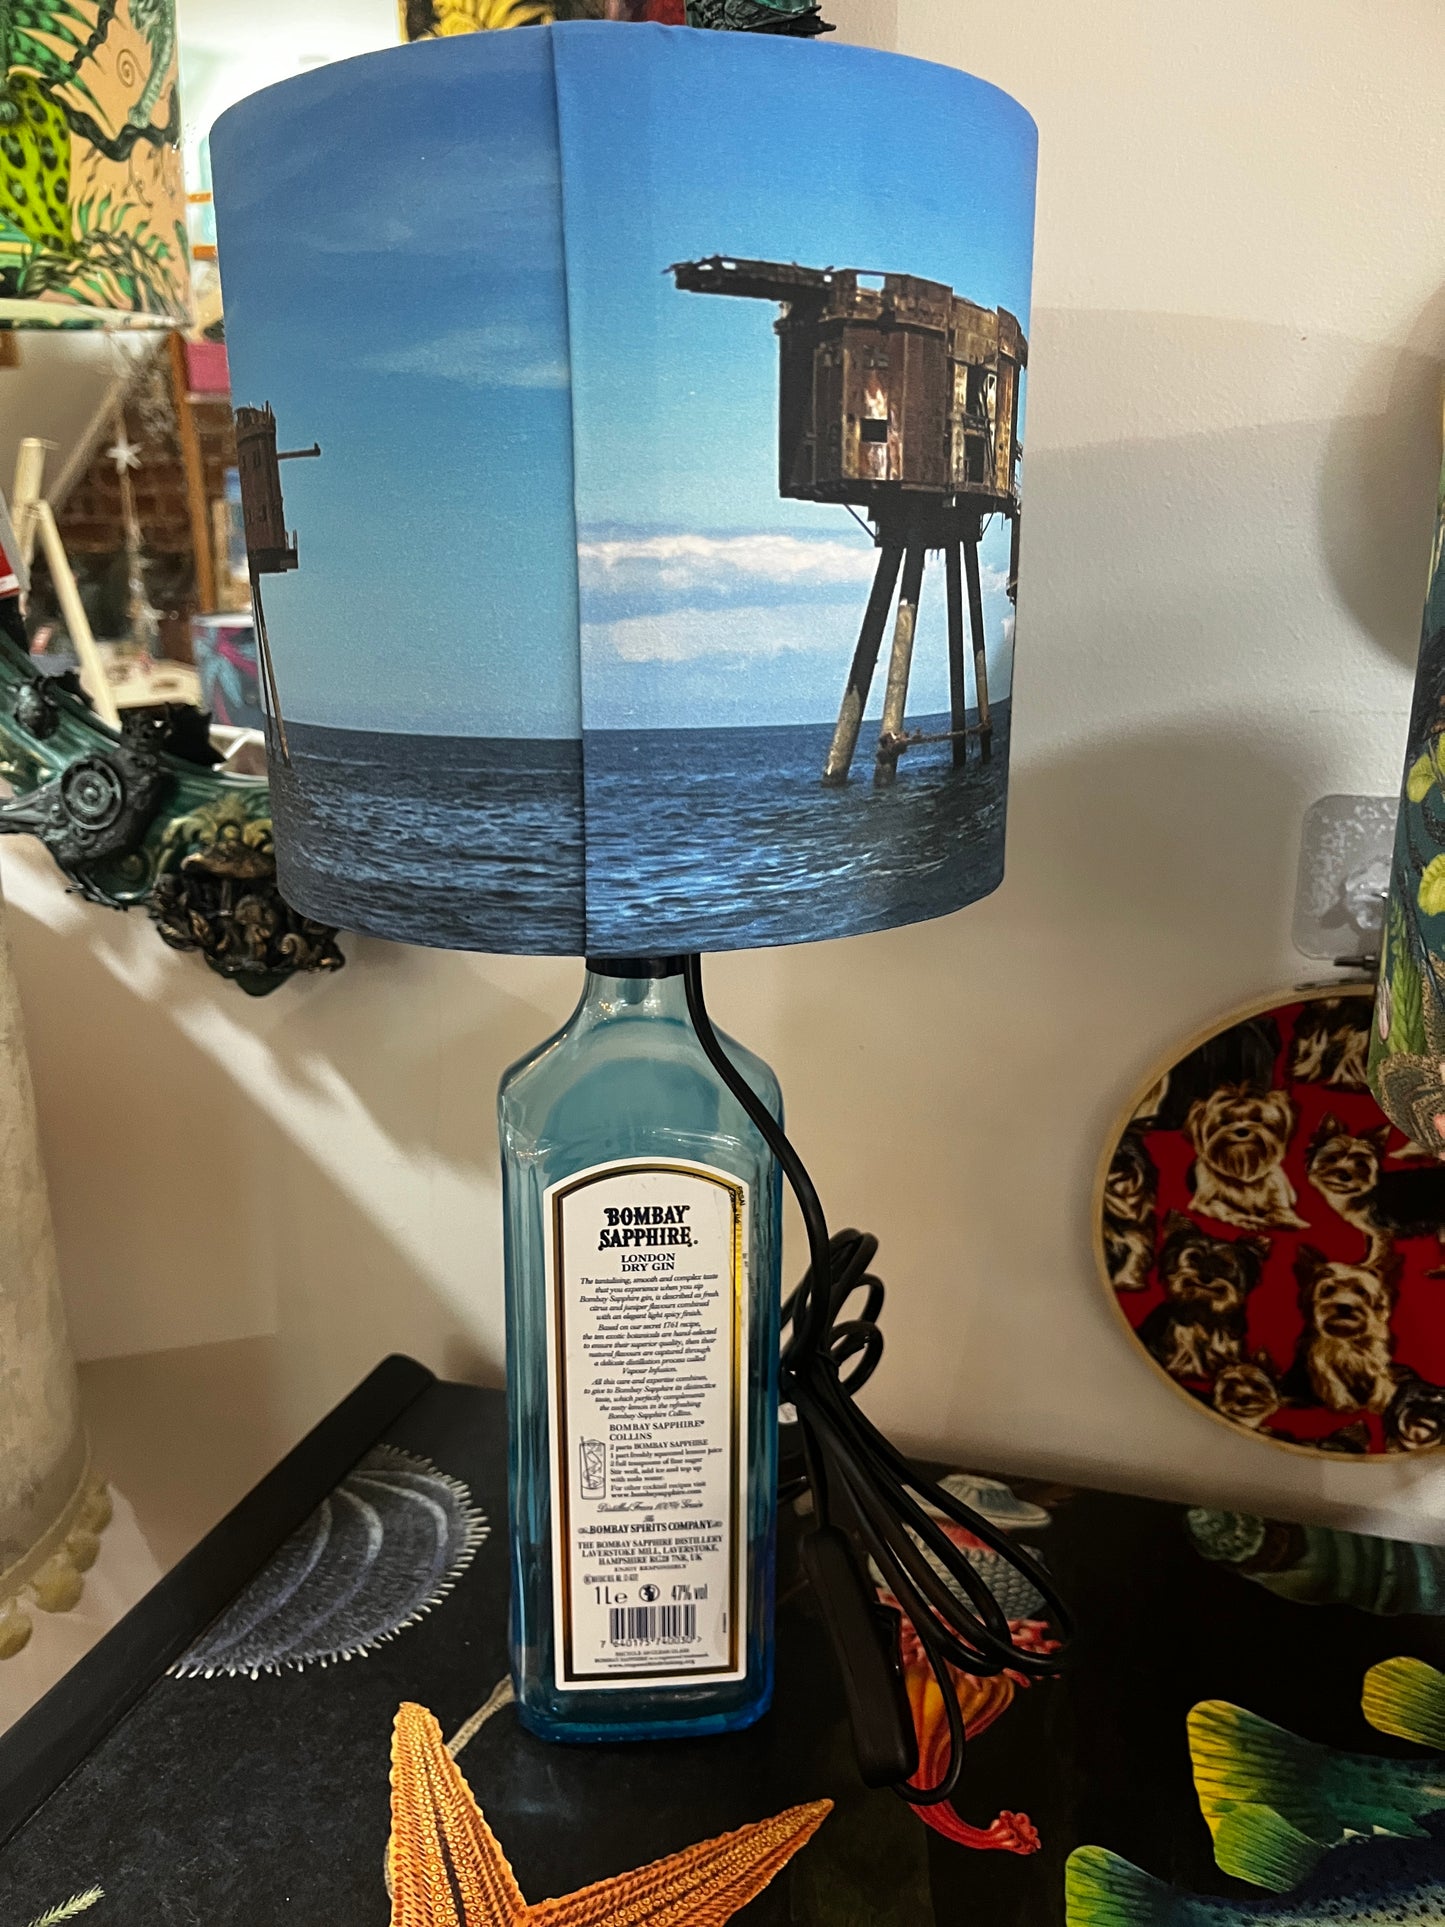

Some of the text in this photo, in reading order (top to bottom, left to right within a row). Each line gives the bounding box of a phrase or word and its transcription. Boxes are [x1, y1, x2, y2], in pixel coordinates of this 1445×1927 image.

[604, 1205, 691, 1226] BOMBAY
[621, 1253, 676, 1263] LONDON
[622, 1262, 675, 1272] DRY GIN
[624, 1286, 659, 1294] experience
[580, 1296, 608, 1304] Bombay
[610, 1295, 639, 1304] Sapphire
[662, 1292, 693, 1300] described
[648, 1312, 663, 1320] light
[622, 1367, 648, 1375] Vapour
[614, 1386, 642, 1394] Bombay
[644, 1385, 673, 1393] Sapphire
[637, 1411, 667, 1419] Sapphire
[609, 1423, 651, 1432] BOMBAY
[609, 1433, 652, 1441] COLLINS
[634, 1441, 668, 1450] BOMBAY
[670, 1439, 709, 1448] SAPPHIRE
[589, 1520, 713, 1534] BOMBAY SPIRITS COMPANY
[578, 1541, 595, 1549] THE
[596, 1540, 631, 1549] BOMBAY
[633, 1538, 673, 1547] SAPPHIRE
[671, 1584, 692, 1601] 47%
[600, 1640, 606, 1648] 7
